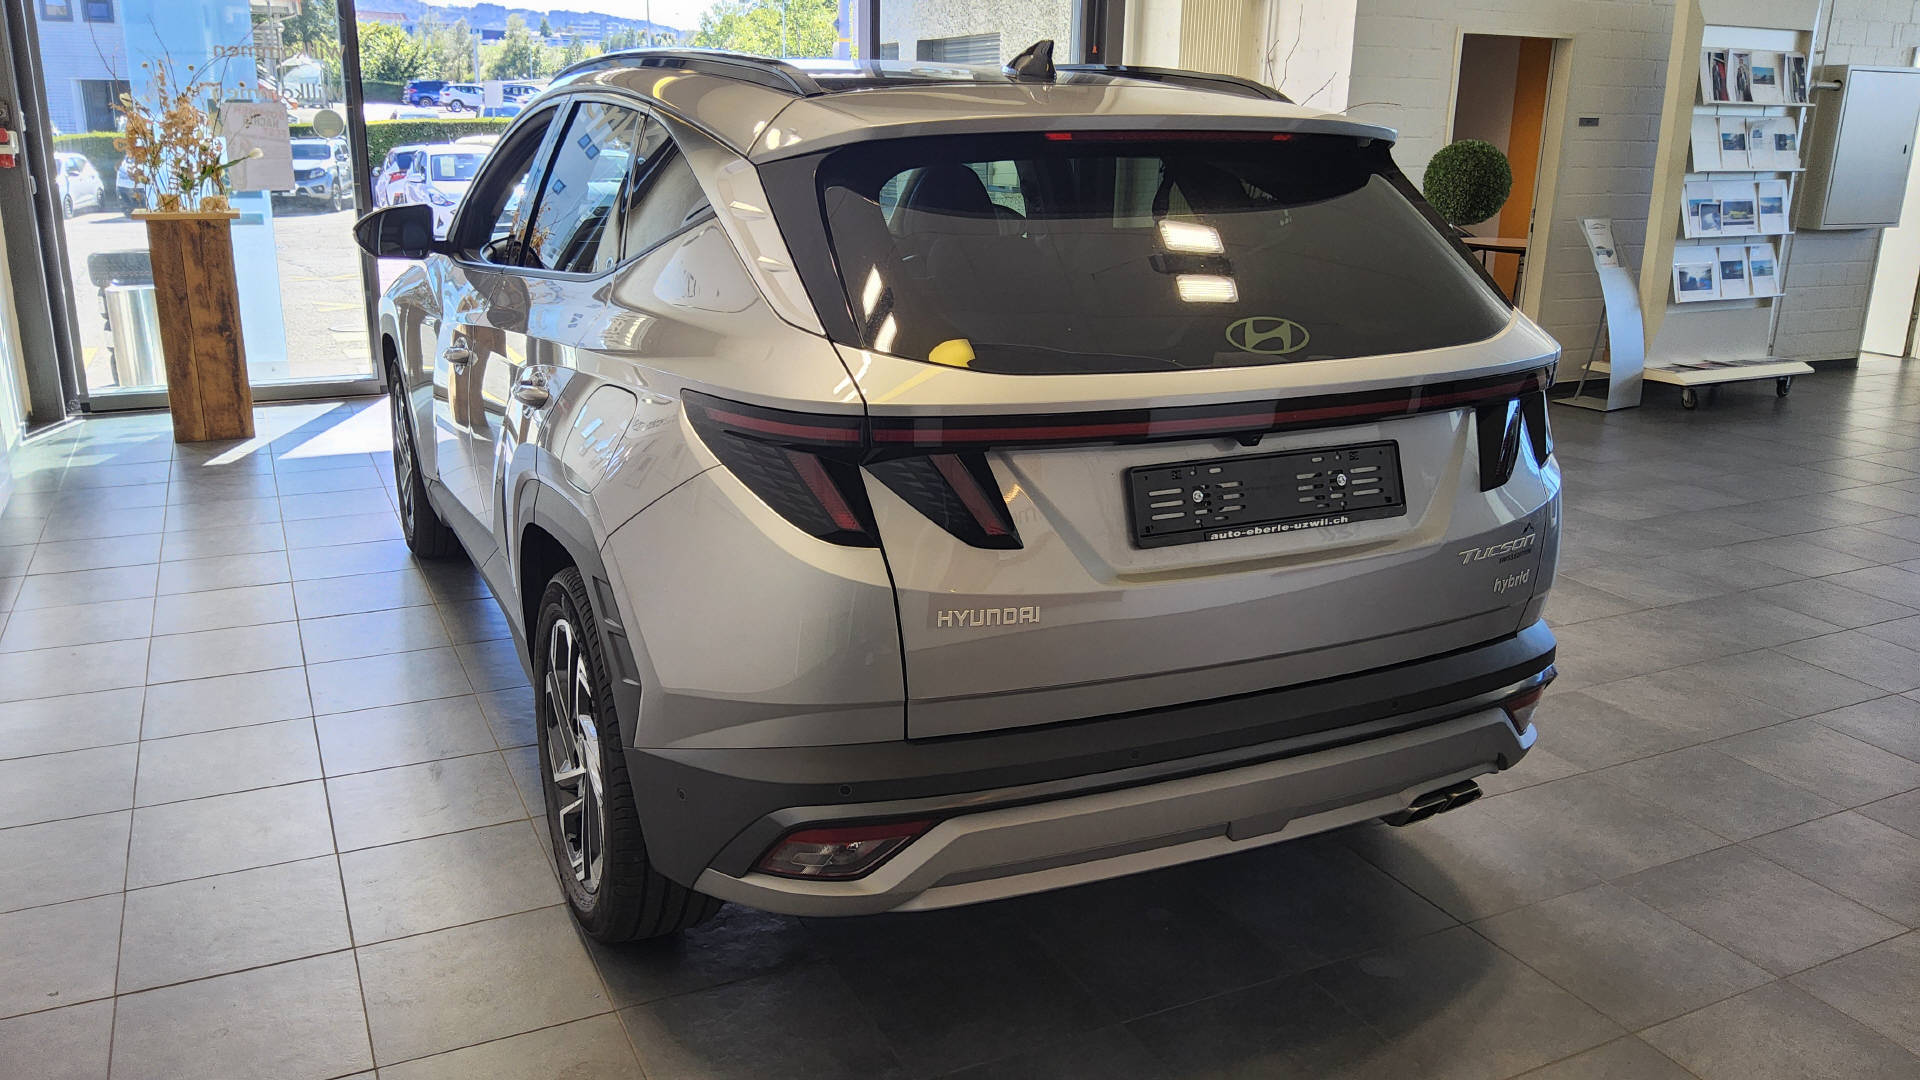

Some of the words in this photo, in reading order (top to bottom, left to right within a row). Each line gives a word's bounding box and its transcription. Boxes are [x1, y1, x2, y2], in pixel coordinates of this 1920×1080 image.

[1210, 515, 1349, 540] auto-eberle-uzwil.ch
[1493, 568, 1530, 594] hybrid
[937, 606, 1041, 628] HYUNDAI
